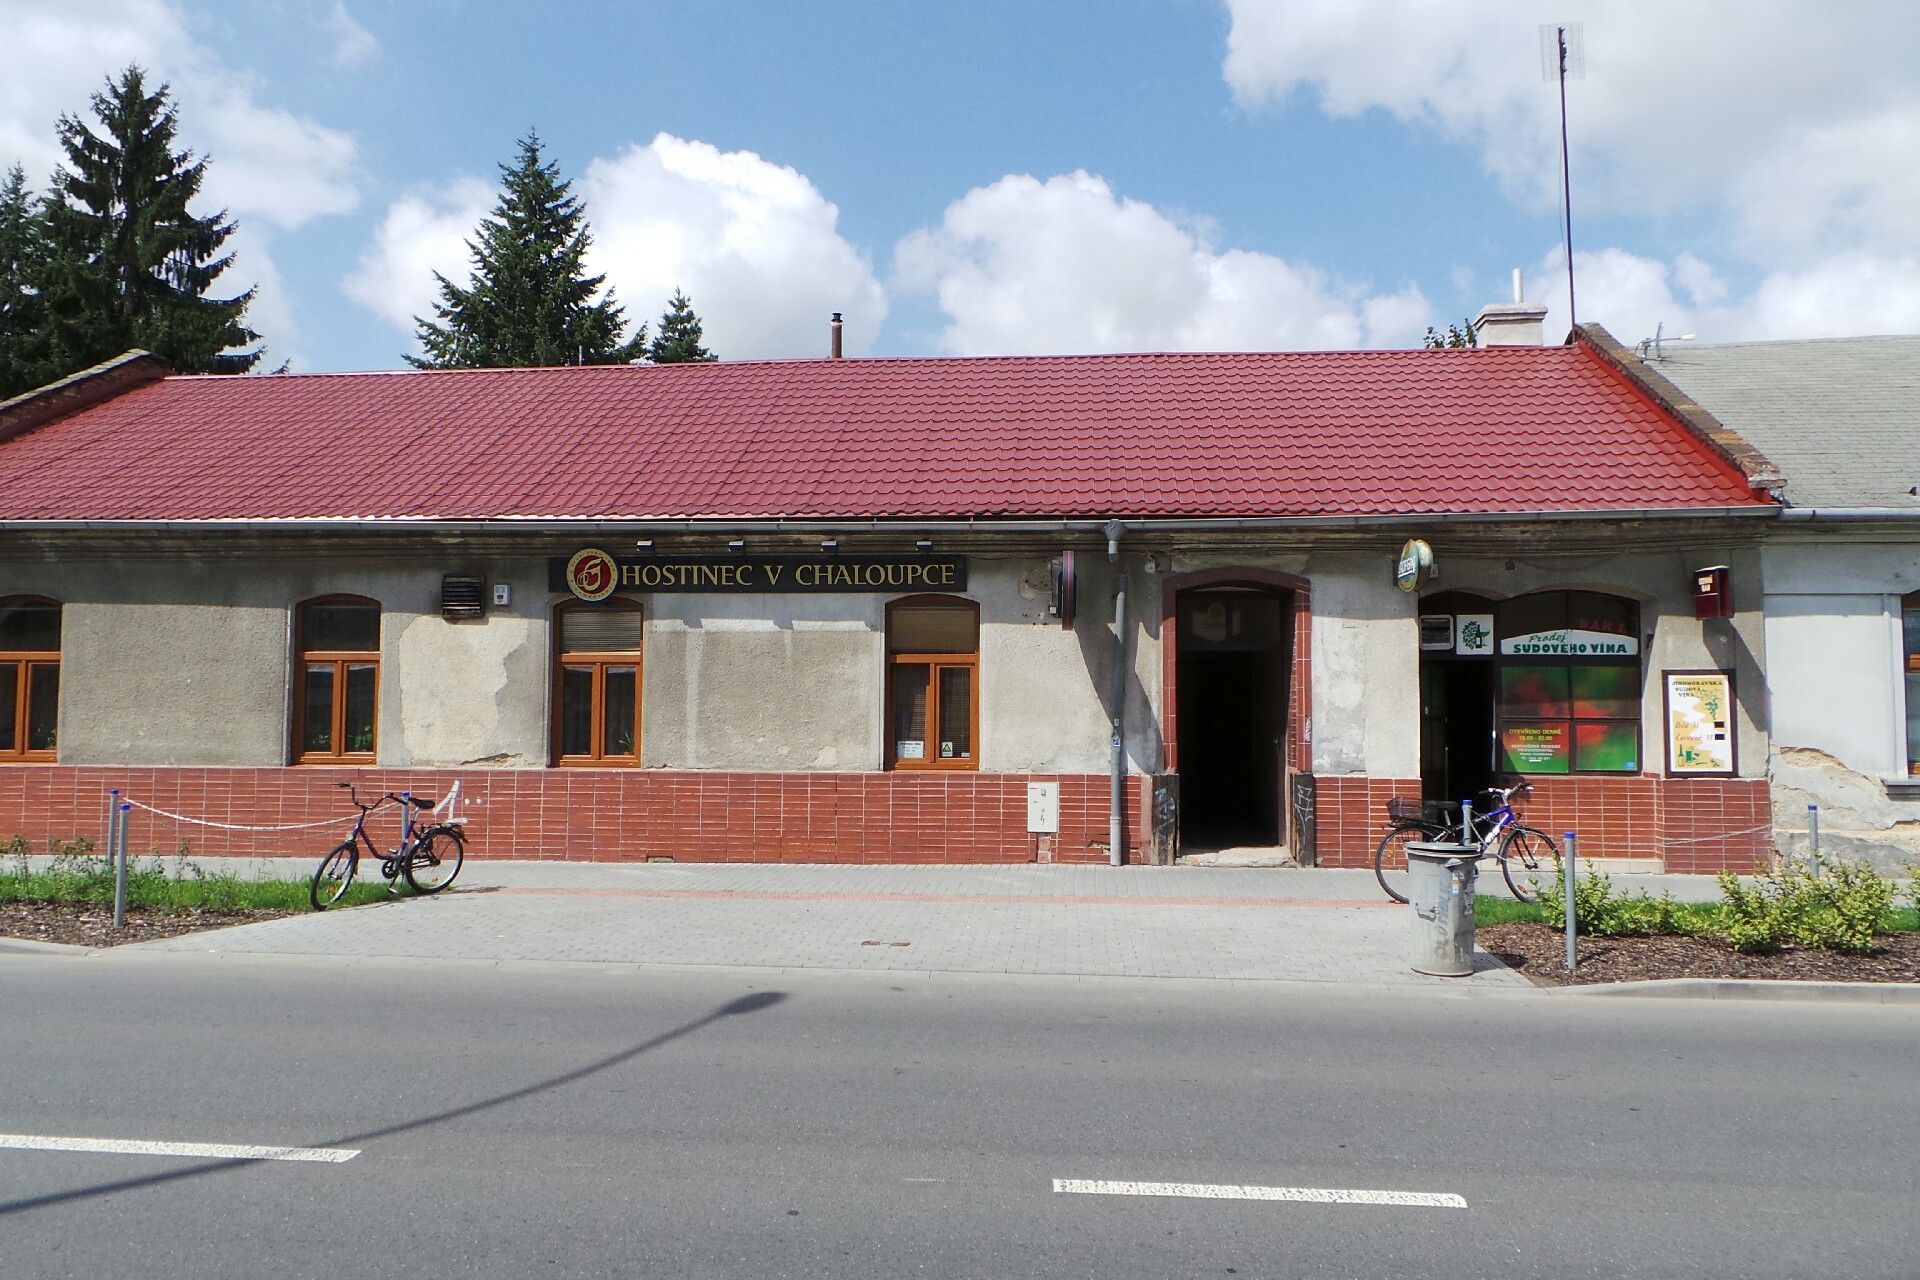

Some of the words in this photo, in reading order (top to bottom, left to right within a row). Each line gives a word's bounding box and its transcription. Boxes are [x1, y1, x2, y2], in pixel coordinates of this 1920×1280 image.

[621, 564, 753, 586] HOSTINEC
[764, 564, 784, 586] V
[795, 563, 956, 586] CHALOUPCE
[1528, 632, 1568, 643] Prodej
[1513, 642, 1588, 654] SUDOVÉHO
[1590, 642, 1628, 654] VÍNA
